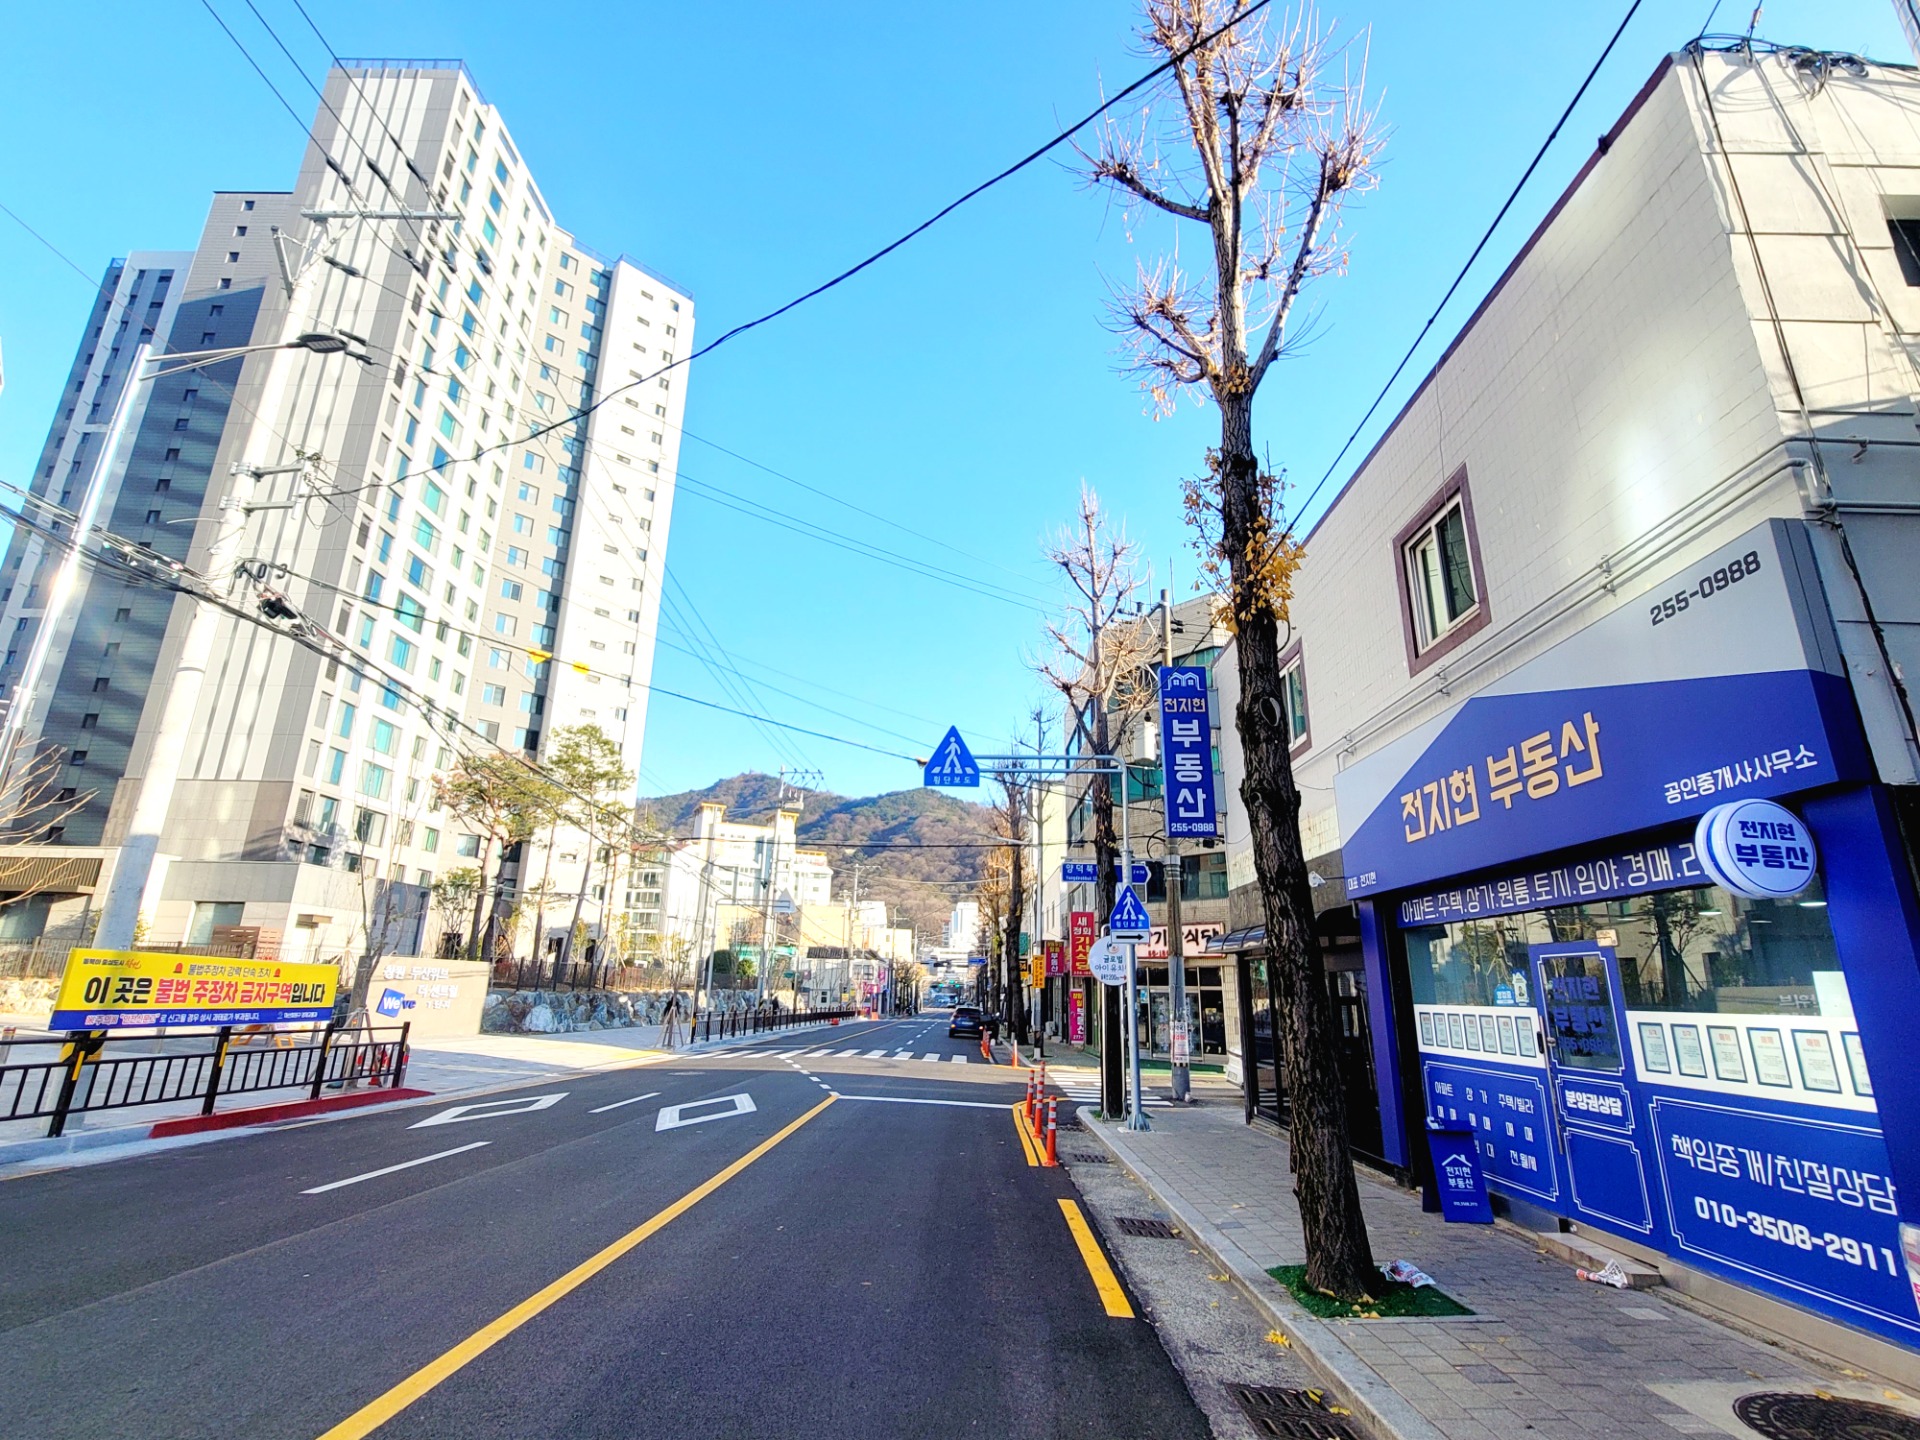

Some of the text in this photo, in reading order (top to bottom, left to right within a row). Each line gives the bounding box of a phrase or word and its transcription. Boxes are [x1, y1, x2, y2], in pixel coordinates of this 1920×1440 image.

[1651, 550, 1762, 626] 255-0988
[1164, 698, 1206, 713] 전지현
[1171, 719, 1207, 818] 부동산
[1401, 711, 1603, 843] 전지현 부동산
[1664, 744, 1818, 804] 공인중개사사무소
[933, 775, 971, 785] 횡단보도
[1171, 822, 1215, 832] 255-0988
[1738, 820, 1797, 842] 전지현
[1735, 843, 1810, 871] 부동산
[1066, 864, 1098, 874] 양덕북
[1360, 871, 1377, 888] 전지현
[1103, 955, 1123, 964] 글로벌
[257, 968, 271, 978] 조치
[411, 966, 449, 981] 두산위브
[84, 977, 326, 1004] 이 곳은 불법 주정차 금지구역입니다
[1552, 976, 1600, 1001] 전지현
[1553, 1004, 1608, 1033] 부동산
[1434, 1081, 1454, 1097] 아파트
[1564, 1090, 1623, 1117] 분양권상담
[1445, 1166, 1472, 1177] 전지현
[1671, 1134, 1898, 1216] 책임중개/친절상담
[1448, 1177, 1474, 1189] 부동산
[1694, 1196, 1898, 1277] 010-3508-2911
